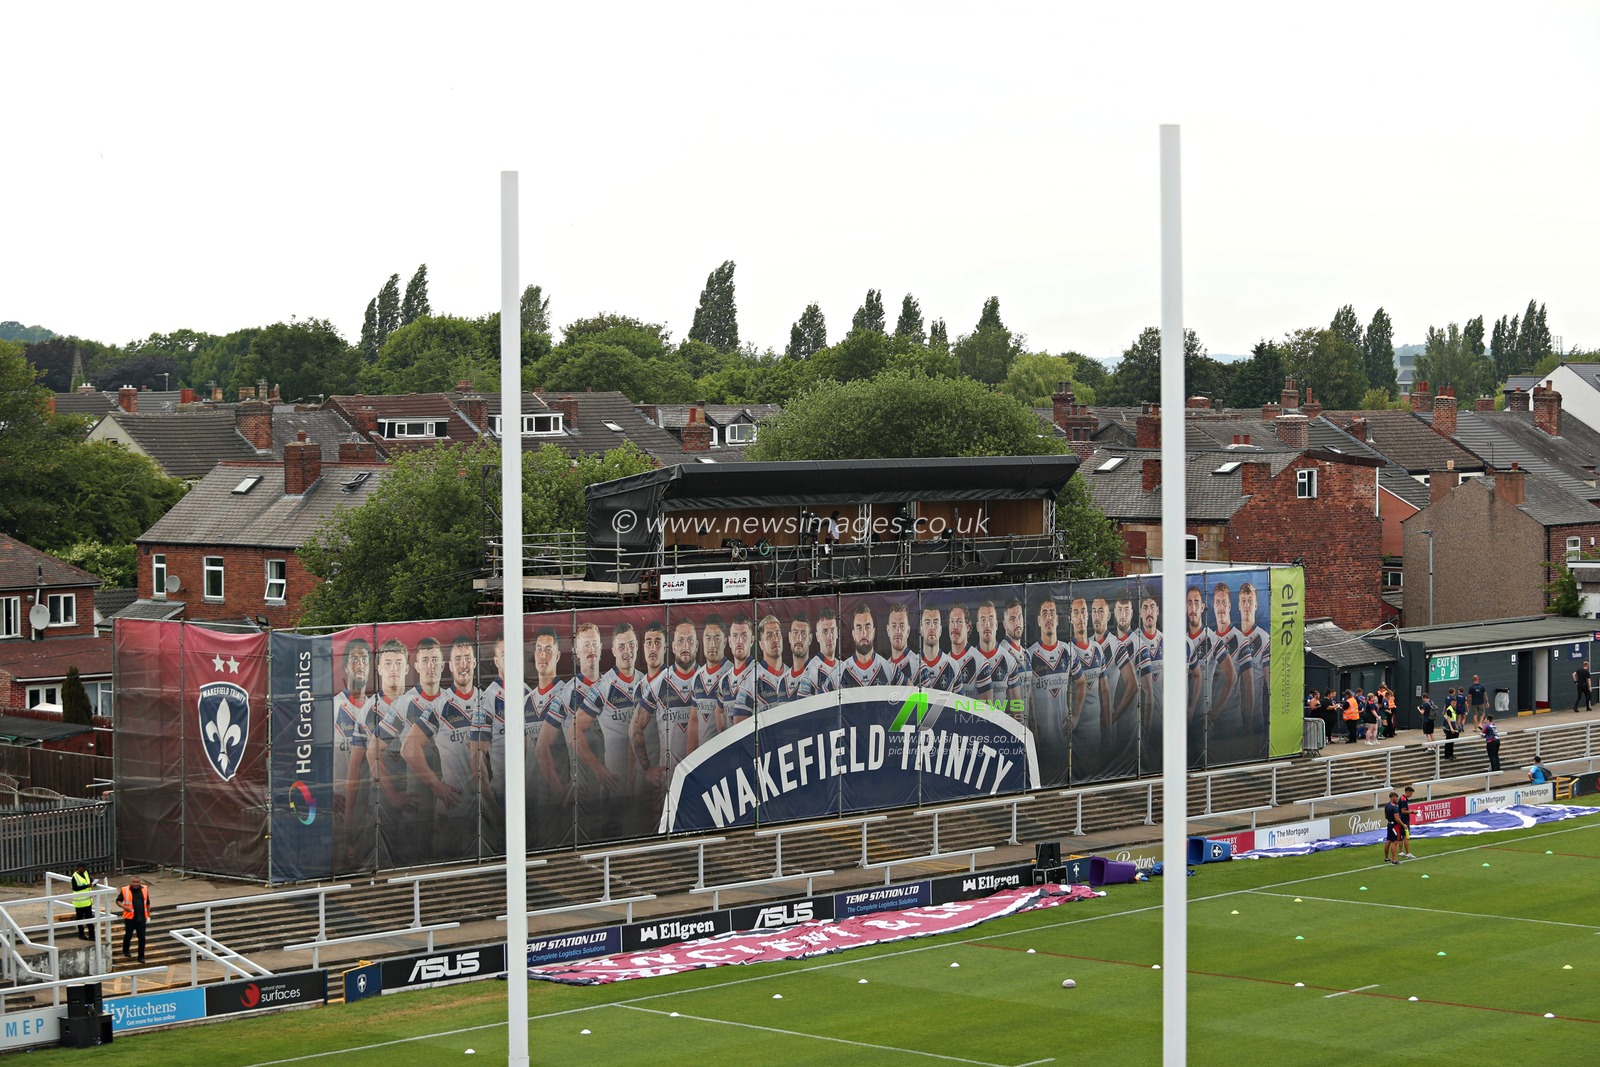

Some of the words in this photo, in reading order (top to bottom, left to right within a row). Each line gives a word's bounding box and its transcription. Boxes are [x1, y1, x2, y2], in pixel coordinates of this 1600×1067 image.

[724, 577, 747, 585] POLAR
[1280, 583, 1299, 646] elite
[1437, 657, 1450, 667] EXIT
[1441, 667, 1446, 677] D
[202, 686, 230, 699] WAKEFIELD
[230, 688, 247, 704] TRINITY
[701, 724, 886, 828] WAKEFIELD
[900, 724, 1014, 795] TRINITY
[1477, 797, 1485, 805] The
[1484, 794, 1506, 804] Mortgage
[1521, 790, 1529, 798] The
[1529, 787, 1549, 797] Mortgage
[1424, 801, 1451, 811] WETHERBY
[1424, 808, 1451, 821] WHALER
[1276, 830, 1286, 838] The
[1286, 826, 1309, 837] Mortgage
[1349, 814, 1382, 834] Prestons
[977, 873, 1020, 890] Ellgren
[845, 893, 869, 905] TEMP
[868, 887, 905, 901] STATION
[903, 885, 920, 896] LTD
[847, 905, 856, 913] The
[856, 903, 878, 912] Complete
[878, 900, 898, 910] Logistics
[898, 897, 918, 906] Solutions
[753, 902, 814, 929] ASUS
[659, 920, 715, 940] Ellgren
[527, 940, 547, 953] EMP
[547, 934, 590, 949] STATION
[589, 931, 607, 943] LTD
[532, 952, 558, 962] Complete
[558, 948, 582, 959] Logistics
[582, 945, 606, 955] Solutions
[408, 951, 480, 983] ASUS
[261, 988, 301, 1003] surfaces
[126, 1019, 136, 1027] Get
[136, 1018, 147, 1026] more
[153, 1015, 162, 1024] less
[162, 1014, 176, 1022] online
